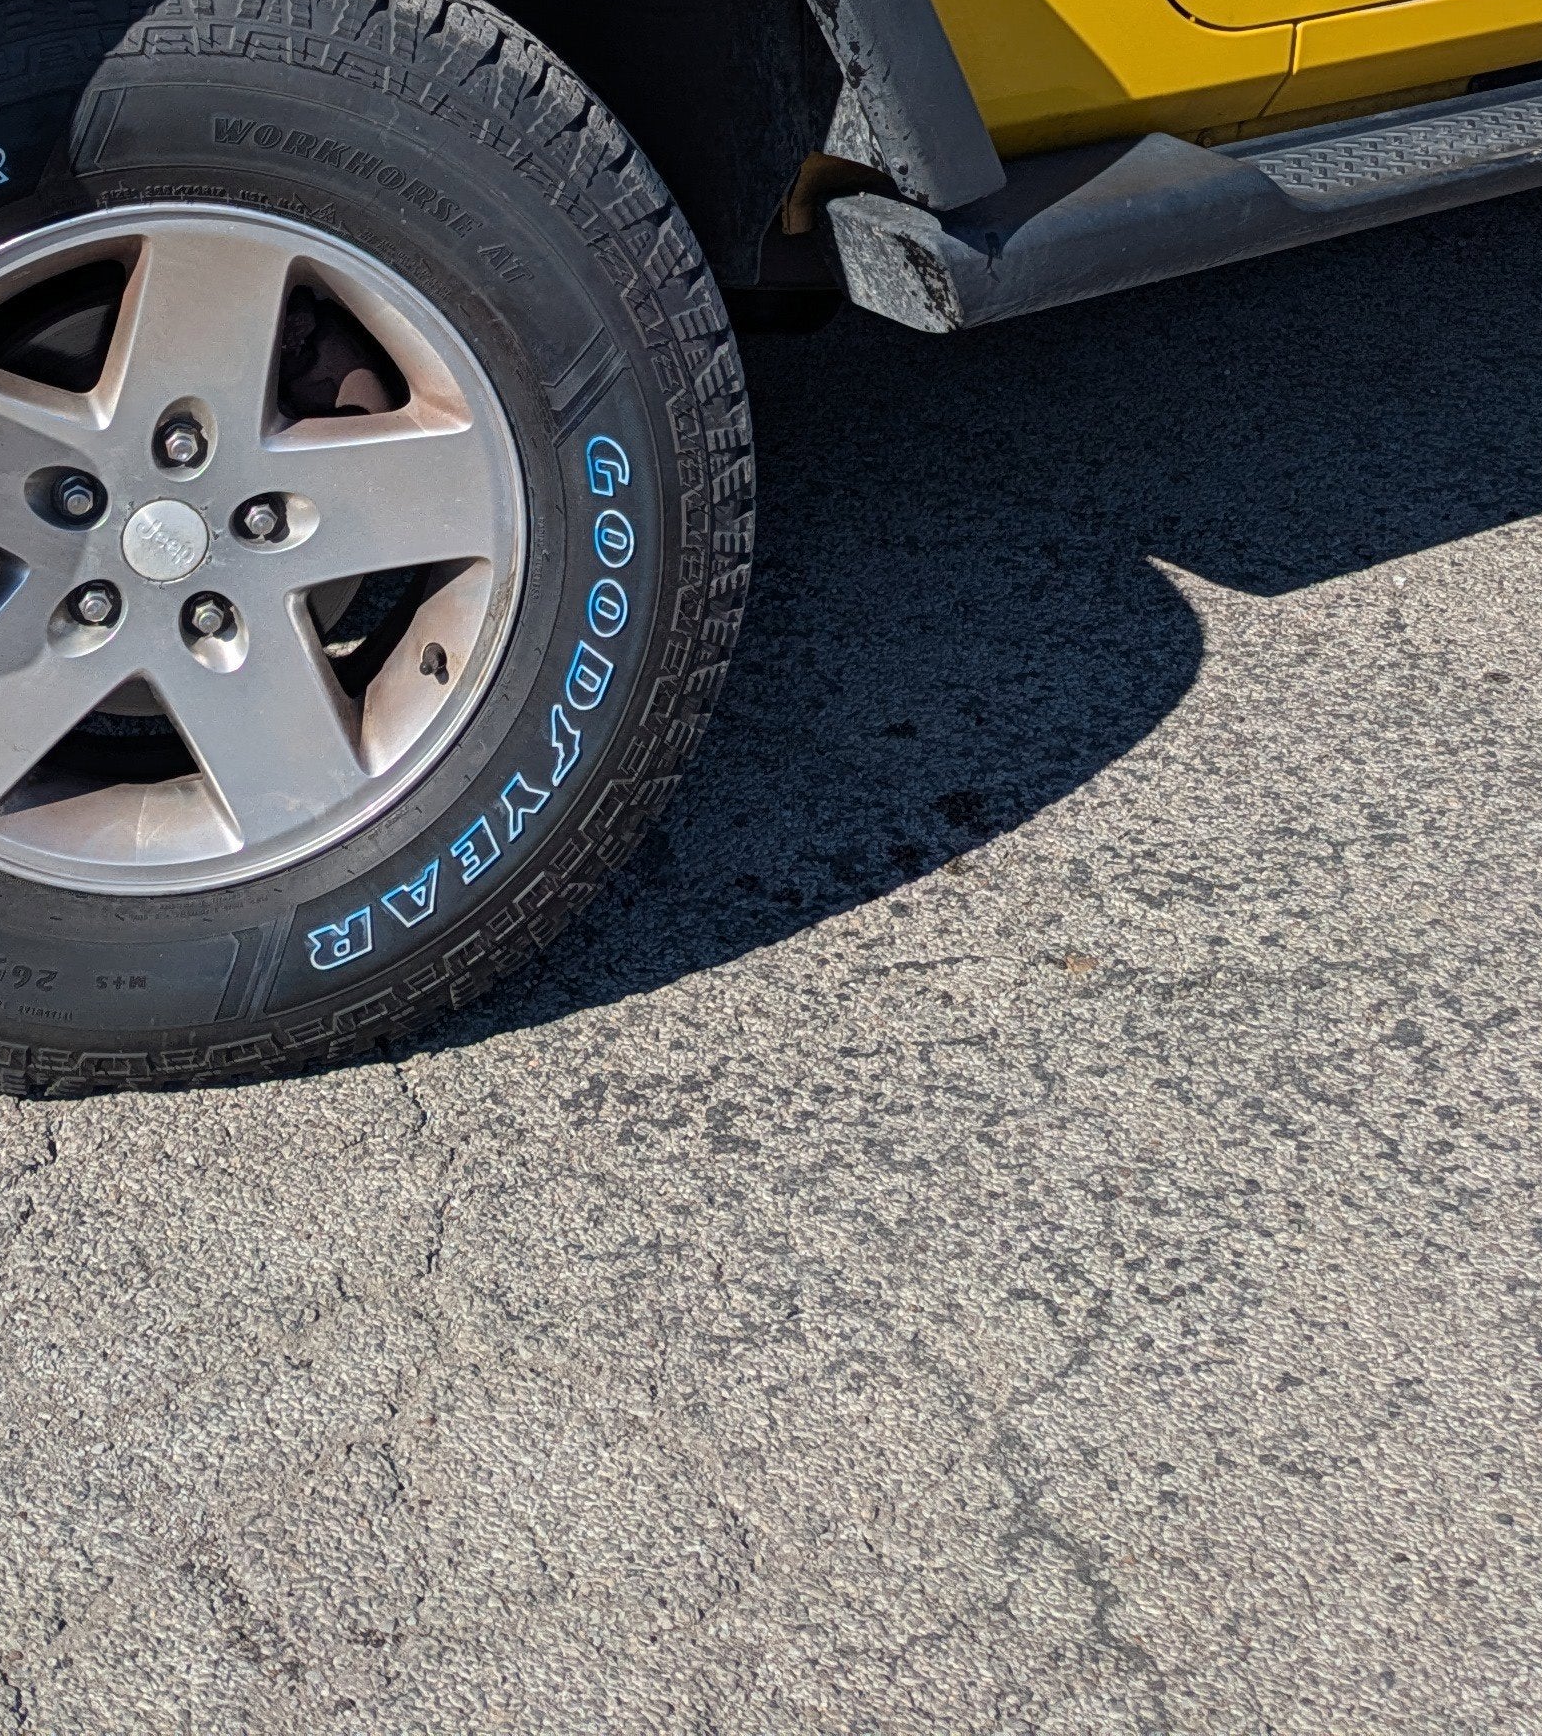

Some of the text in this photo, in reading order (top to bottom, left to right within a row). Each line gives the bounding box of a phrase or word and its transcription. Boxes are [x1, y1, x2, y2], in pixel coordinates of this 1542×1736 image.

[212, 116, 485, 239] WORKHORSE
[478, 241, 535, 287] AT
[307, 432, 637, 974] GOODYEAR
